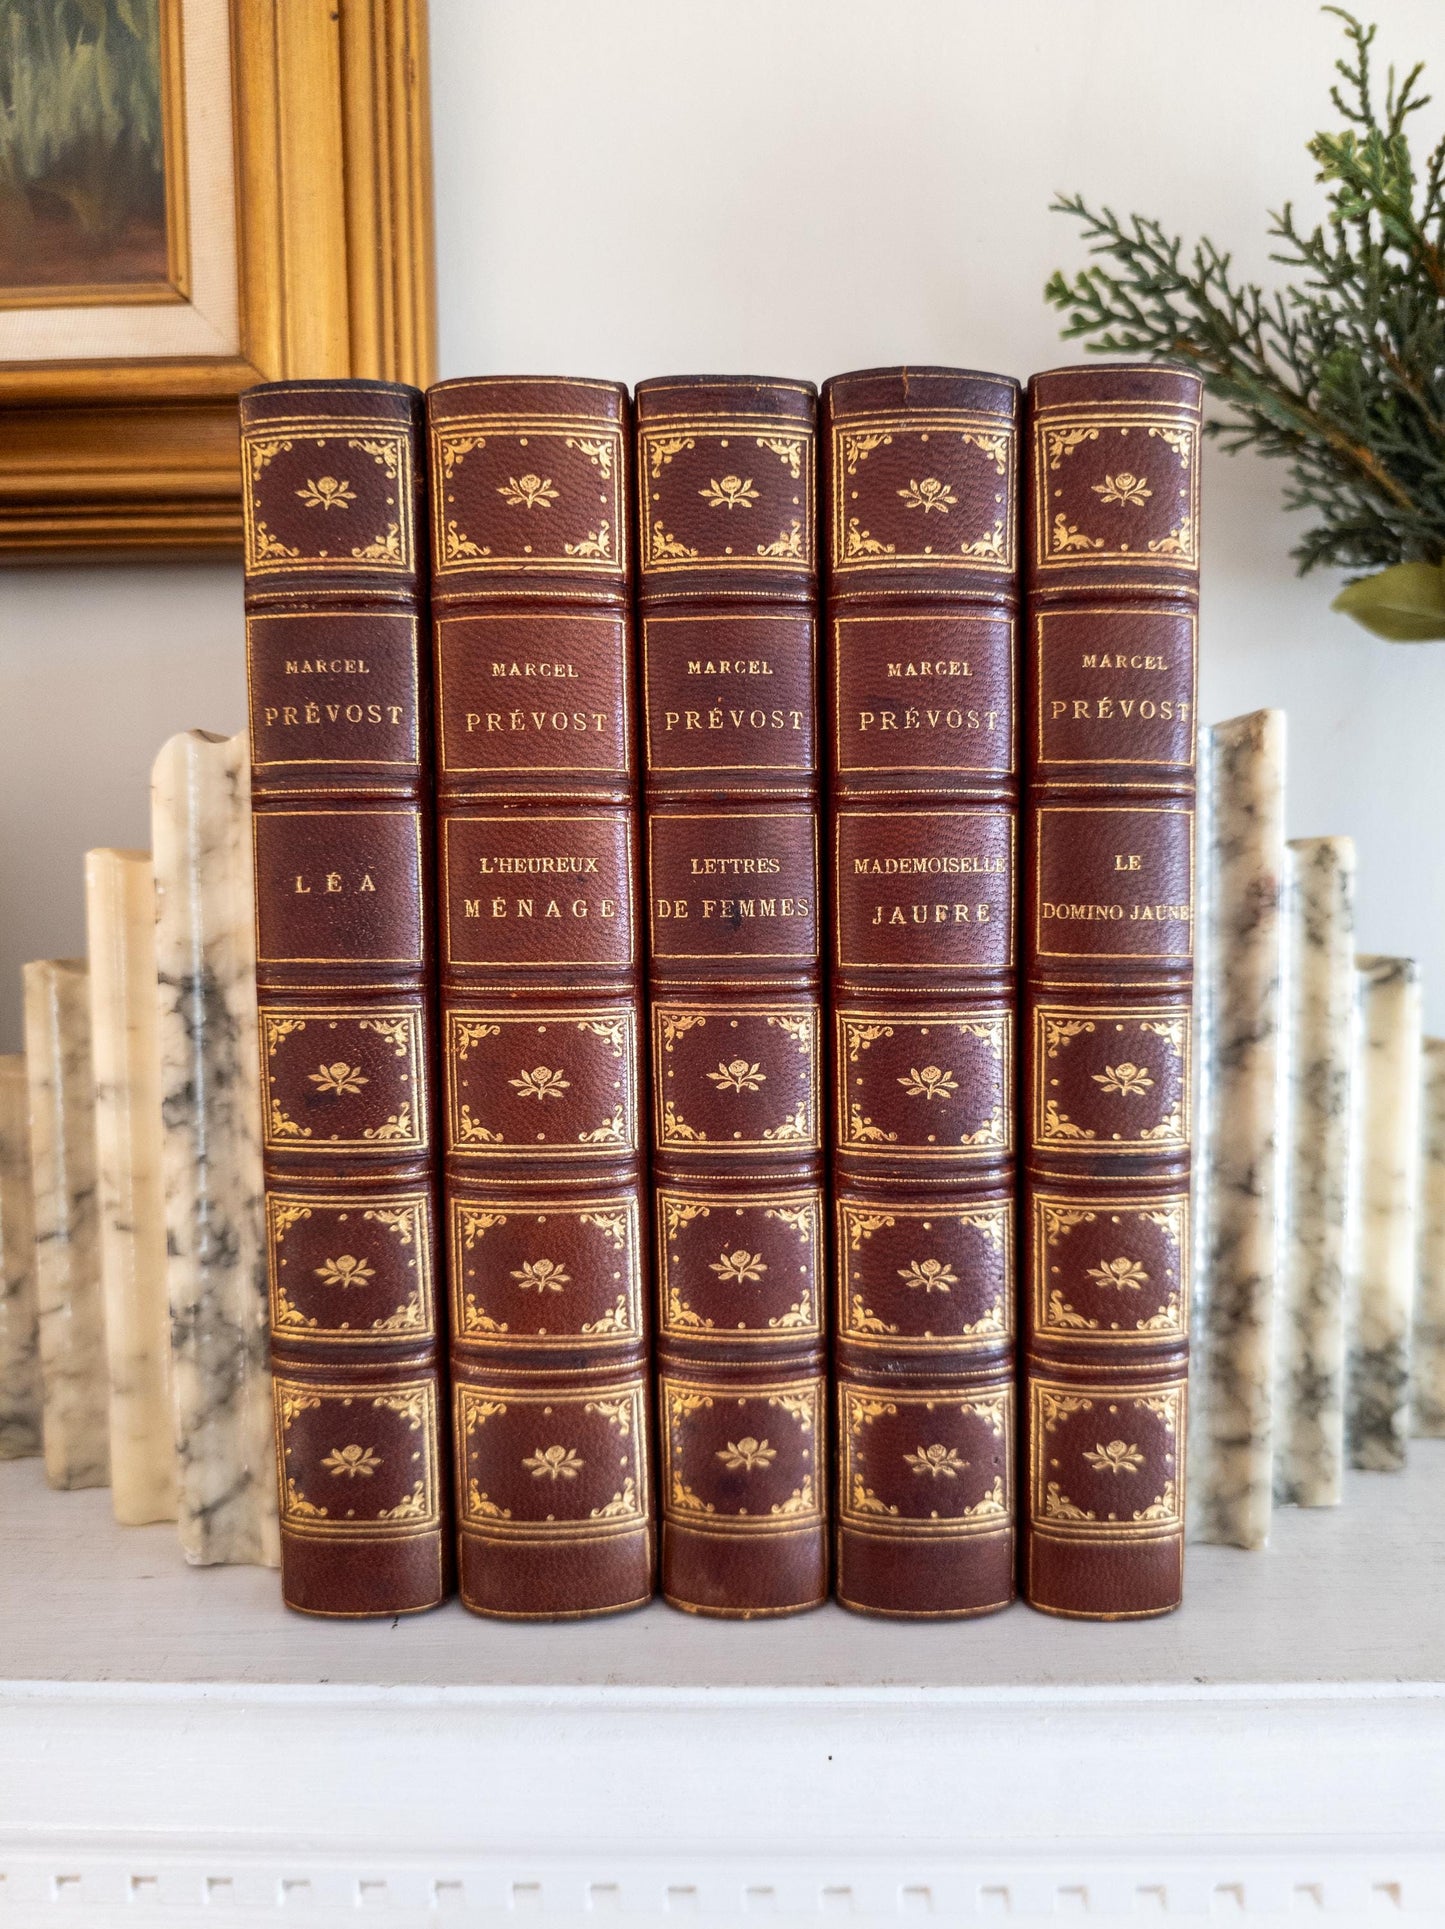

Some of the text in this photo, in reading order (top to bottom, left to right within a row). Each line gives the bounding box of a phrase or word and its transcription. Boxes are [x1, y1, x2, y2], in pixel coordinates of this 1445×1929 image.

[285, 660, 370, 674] MARCEL
[491, 663, 579, 678] MARCEL
[687, 660, 773, 675] MARCEL
[887, 661, 973, 678] MARCEL
[1082, 654, 1168, 671] MARCEL
[264, 702, 403, 726] PRÉVOST
[664, 707, 804, 731] PRÉVOST
[858, 707, 998, 731] PRÉVOST
[1050, 697, 1190, 722] PRÉVOST
[465, 709, 608, 732] PRÉVOST
[479, 857, 599, 874] L'HEUREUX
[690, 857, 781, 875] LETTRES
[853, 857, 1007, 875] MADEMOISELLE
[1114, 855, 1142, 871] LE
[294, 872, 376, 893] LÉA
[463, 897, 616, 919] MÉNAGE
[657, 898, 809, 919] DE FEMMES
[872, 904, 991, 925] JAUFRE
[1042, 902, 1191, 921] DOMINO JAUNE
